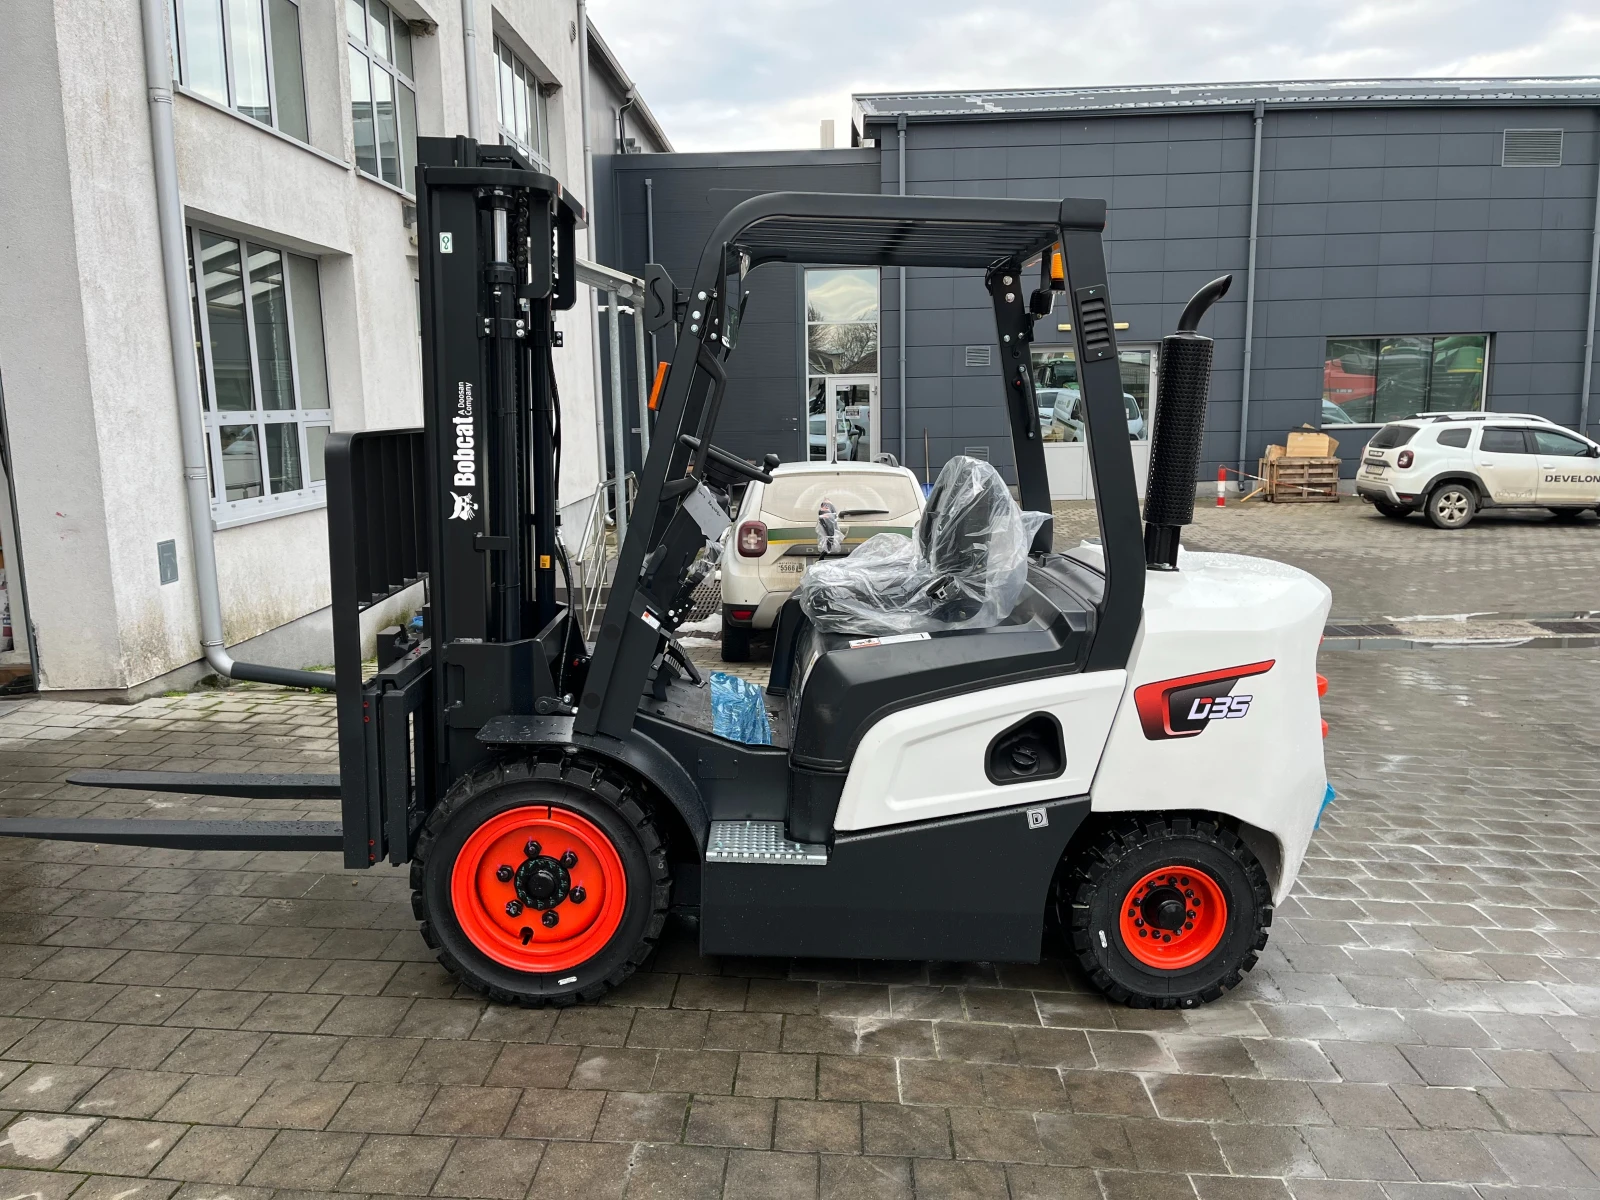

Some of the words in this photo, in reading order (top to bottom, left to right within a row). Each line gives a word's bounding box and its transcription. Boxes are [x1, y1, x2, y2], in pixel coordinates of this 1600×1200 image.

[465, 382, 473, 416] Company
[452, 416, 476, 487] Bobcat
[1545, 475, 1600, 483] DEVELON
[1187, 694, 1253, 720] D35
